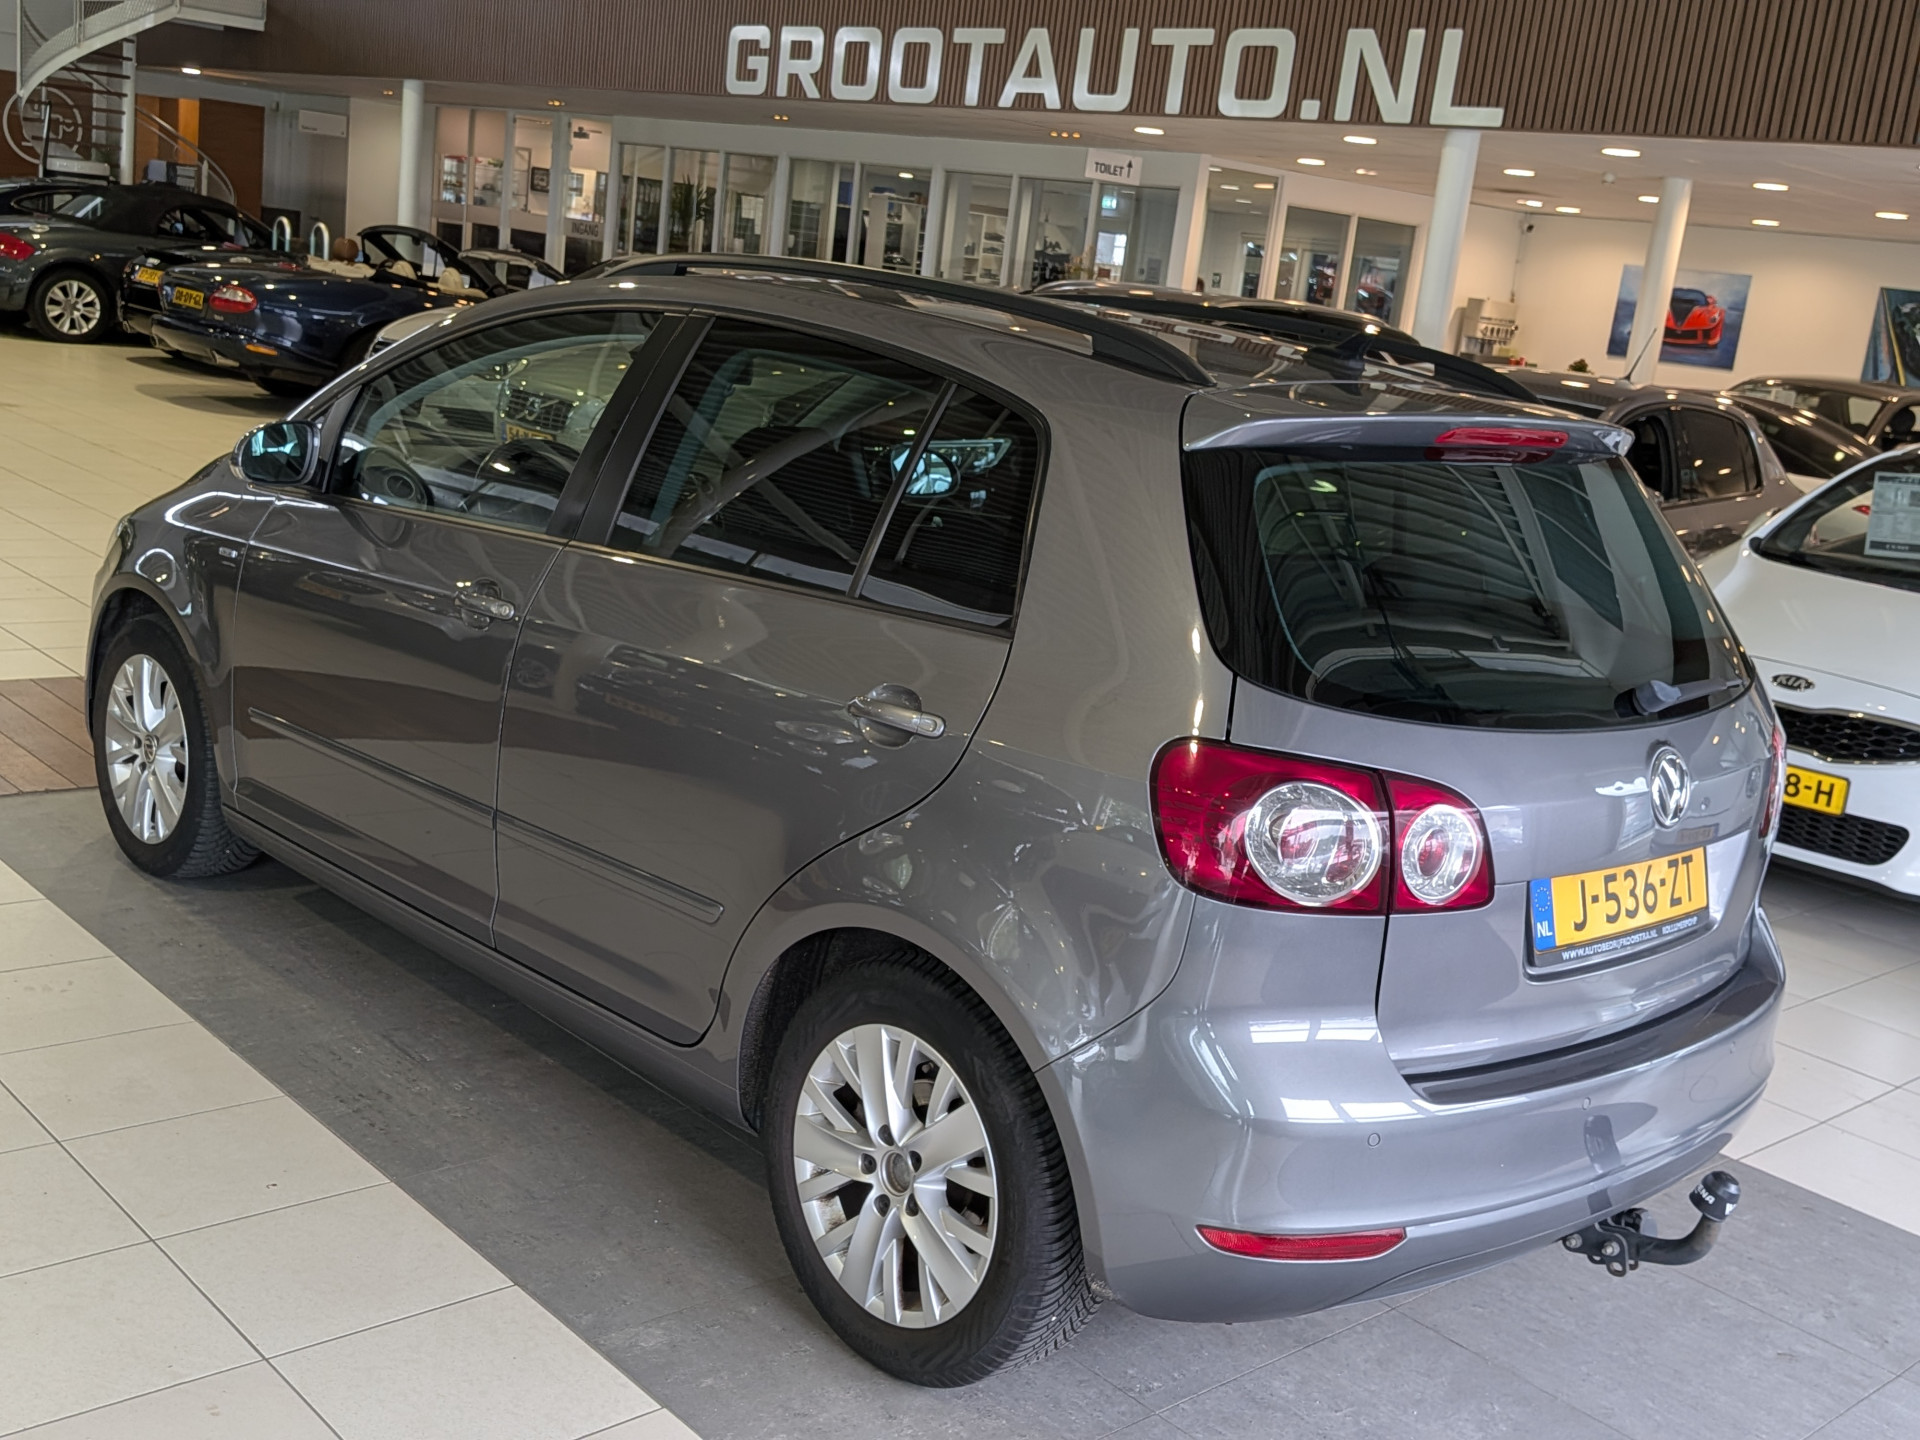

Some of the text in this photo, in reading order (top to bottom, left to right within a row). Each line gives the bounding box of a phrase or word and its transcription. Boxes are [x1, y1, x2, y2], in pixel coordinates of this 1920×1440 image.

[726, 25, 1505, 127] GROOTAUTO.NL
[1094, 161, 1125, 177] TOILET
[571, 222, 599, 238] INGANG
[1776, 675, 1808, 688] KIA
[1573, 855, 1693, 931] J-536-ZT
[1537, 921, 1553, 938] NL
